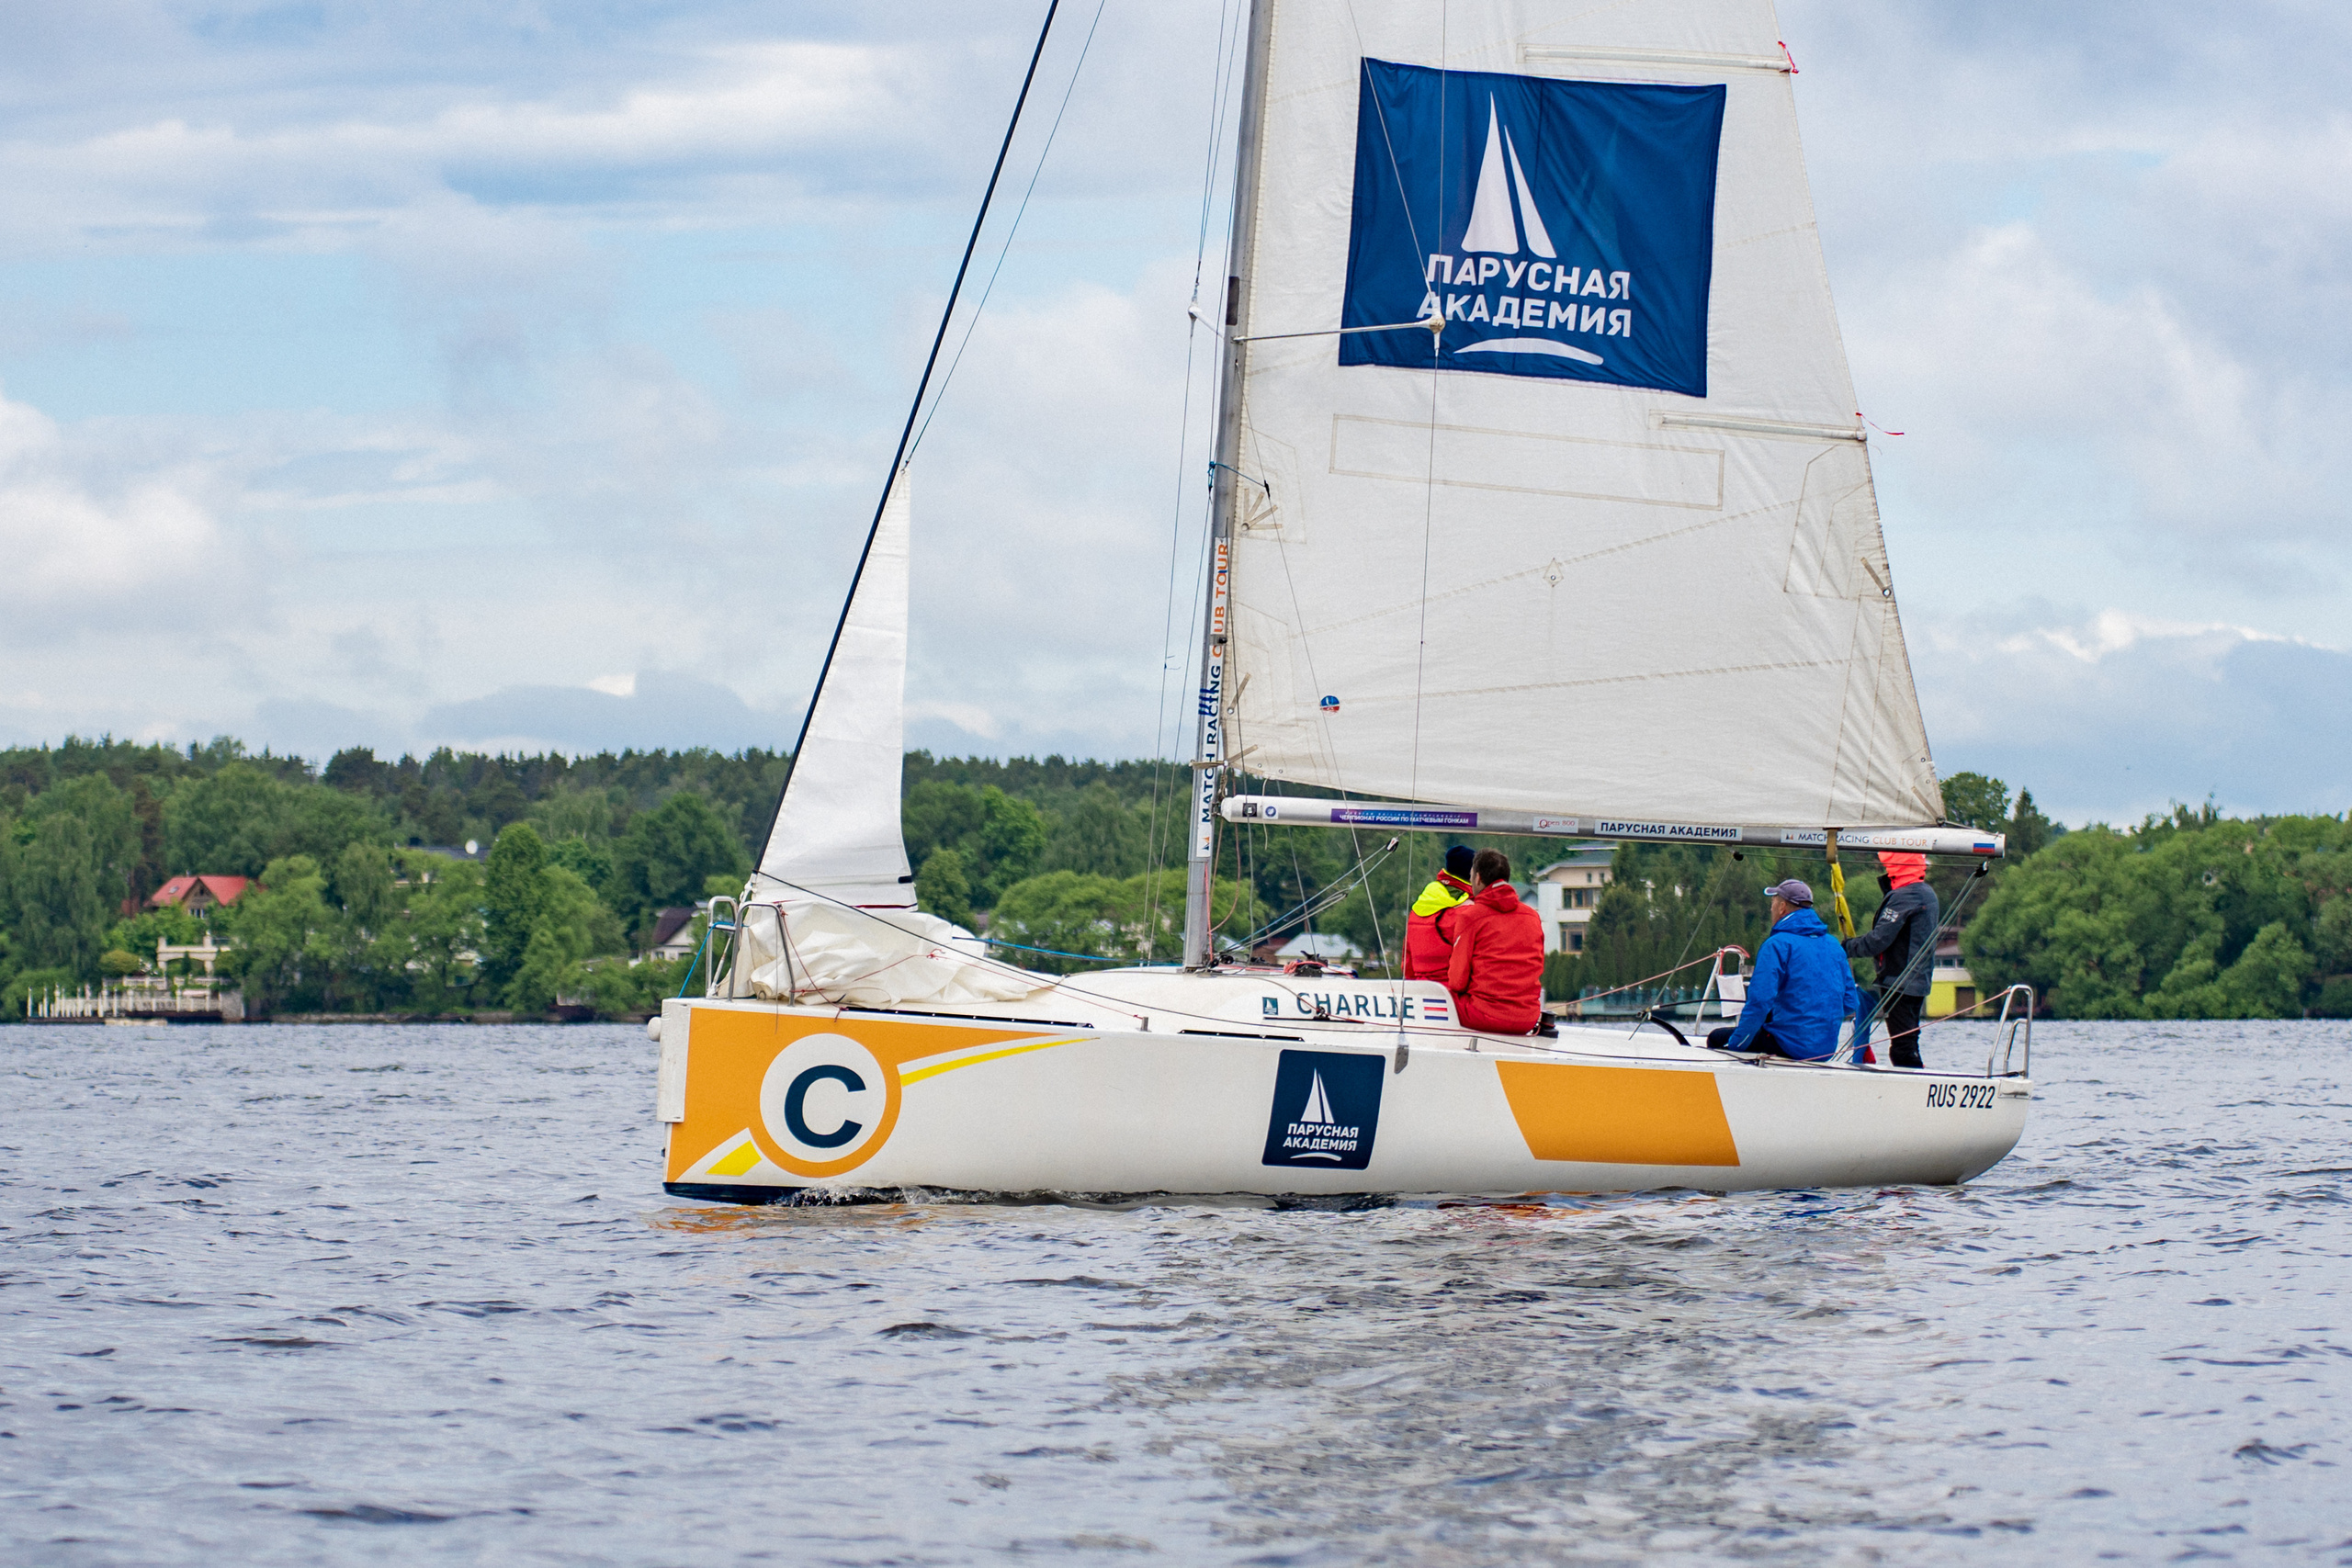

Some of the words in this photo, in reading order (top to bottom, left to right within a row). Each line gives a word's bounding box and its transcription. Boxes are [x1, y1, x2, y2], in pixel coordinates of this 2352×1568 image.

[1427, 254, 1631, 300] ПАРУСНАЯ
[1416, 291, 1632, 338] АКАДЕМИЯ
[1216, 544, 1228, 599] TOUR
[1212, 605, 1226, 658] CUB
[1206, 665, 1221, 745] RACING
[1600, 822, 1666, 835] ПАРУСНАЯ
[1669, 826, 1737, 838] АКАДЕМИЯ
[1871, 836, 1897, 846] CLUB
[1900, 838, 1928, 847] TOUR
[1296, 992, 1416, 1019] CHARLIE
[785, 1065, 866, 1148] C
[1927, 1084, 1958, 1108] RUS
[1959, 1085, 1996, 1110] 2922
[1283, 1134, 1358, 1152] АКАДЕМИЯ
[1287, 1122, 1359, 1139] ПАРУСНАЯ
